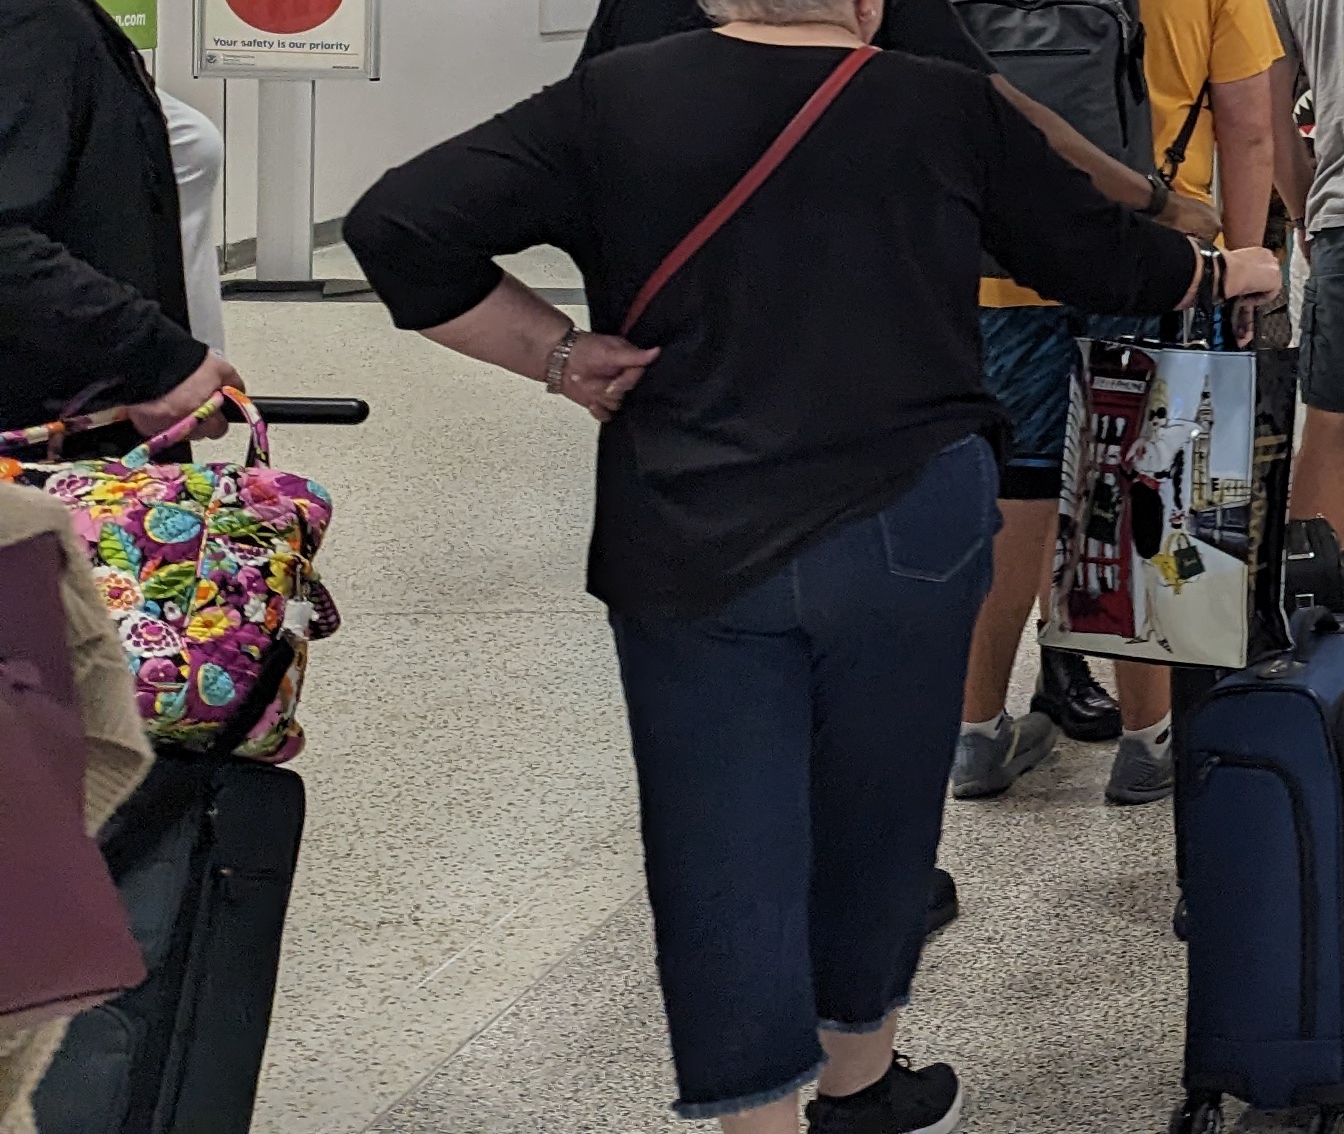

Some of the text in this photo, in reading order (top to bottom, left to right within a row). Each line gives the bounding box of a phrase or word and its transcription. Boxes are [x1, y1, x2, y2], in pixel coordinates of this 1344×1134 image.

[213, 38, 350, 52] Your safety is our priority
